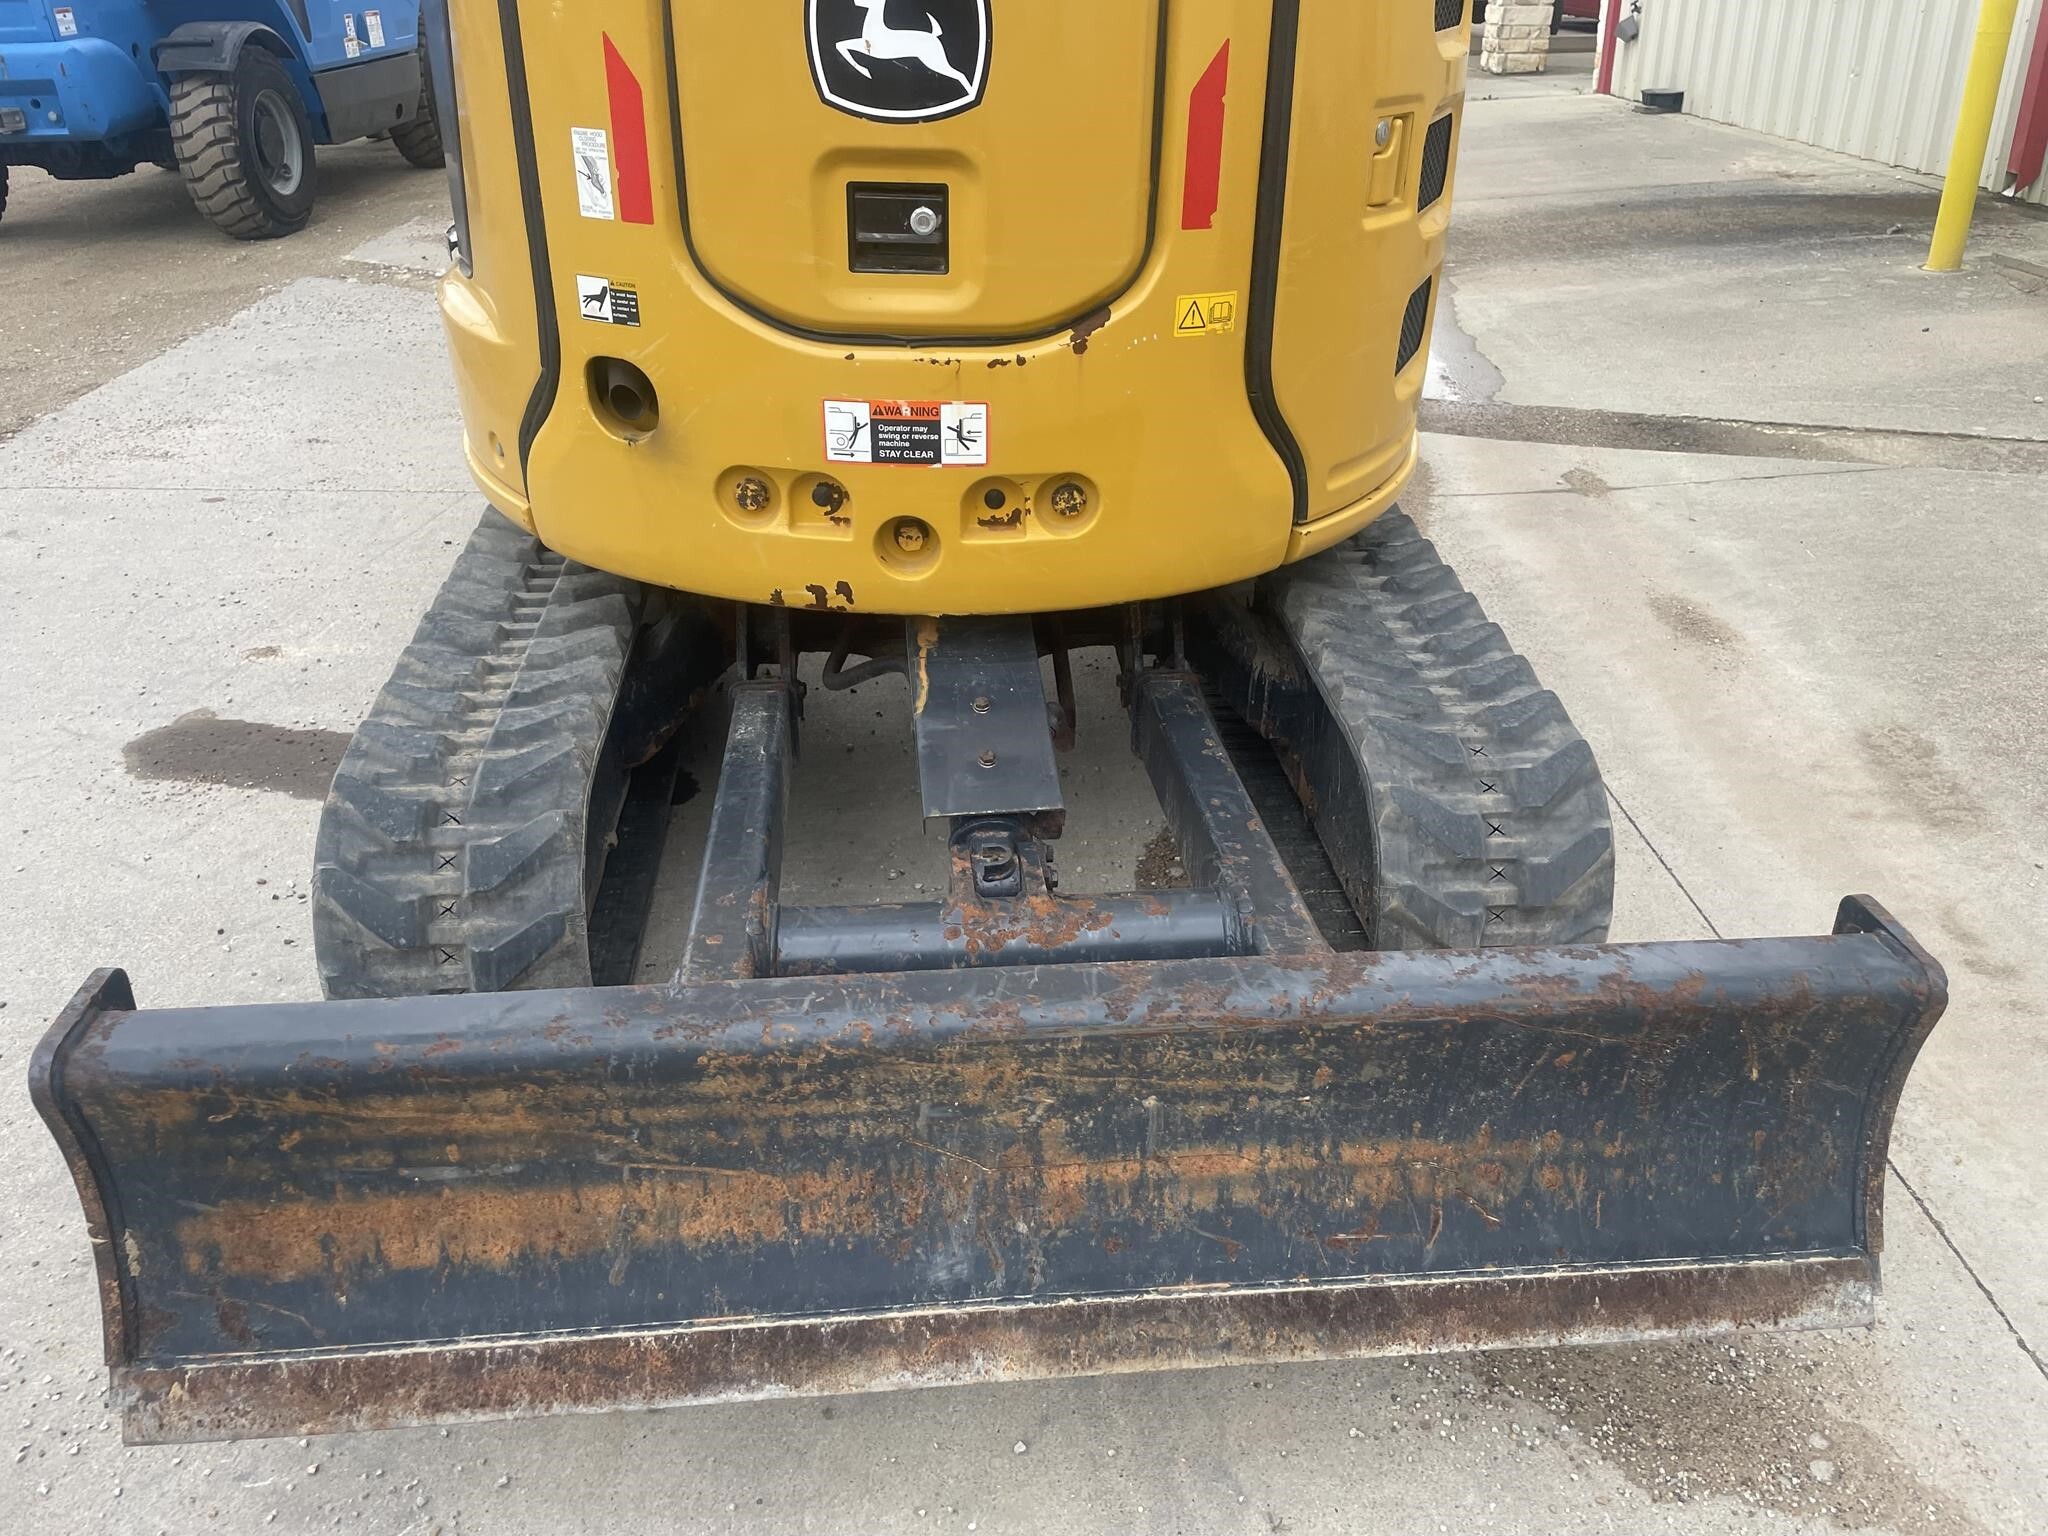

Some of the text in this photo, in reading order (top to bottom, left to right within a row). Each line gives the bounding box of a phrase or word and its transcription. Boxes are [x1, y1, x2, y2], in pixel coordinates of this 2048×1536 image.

[878, 424, 911, 432] Operator
[878, 432, 900, 440] swing
[879, 449, 934, 458] STAY CLEAR
